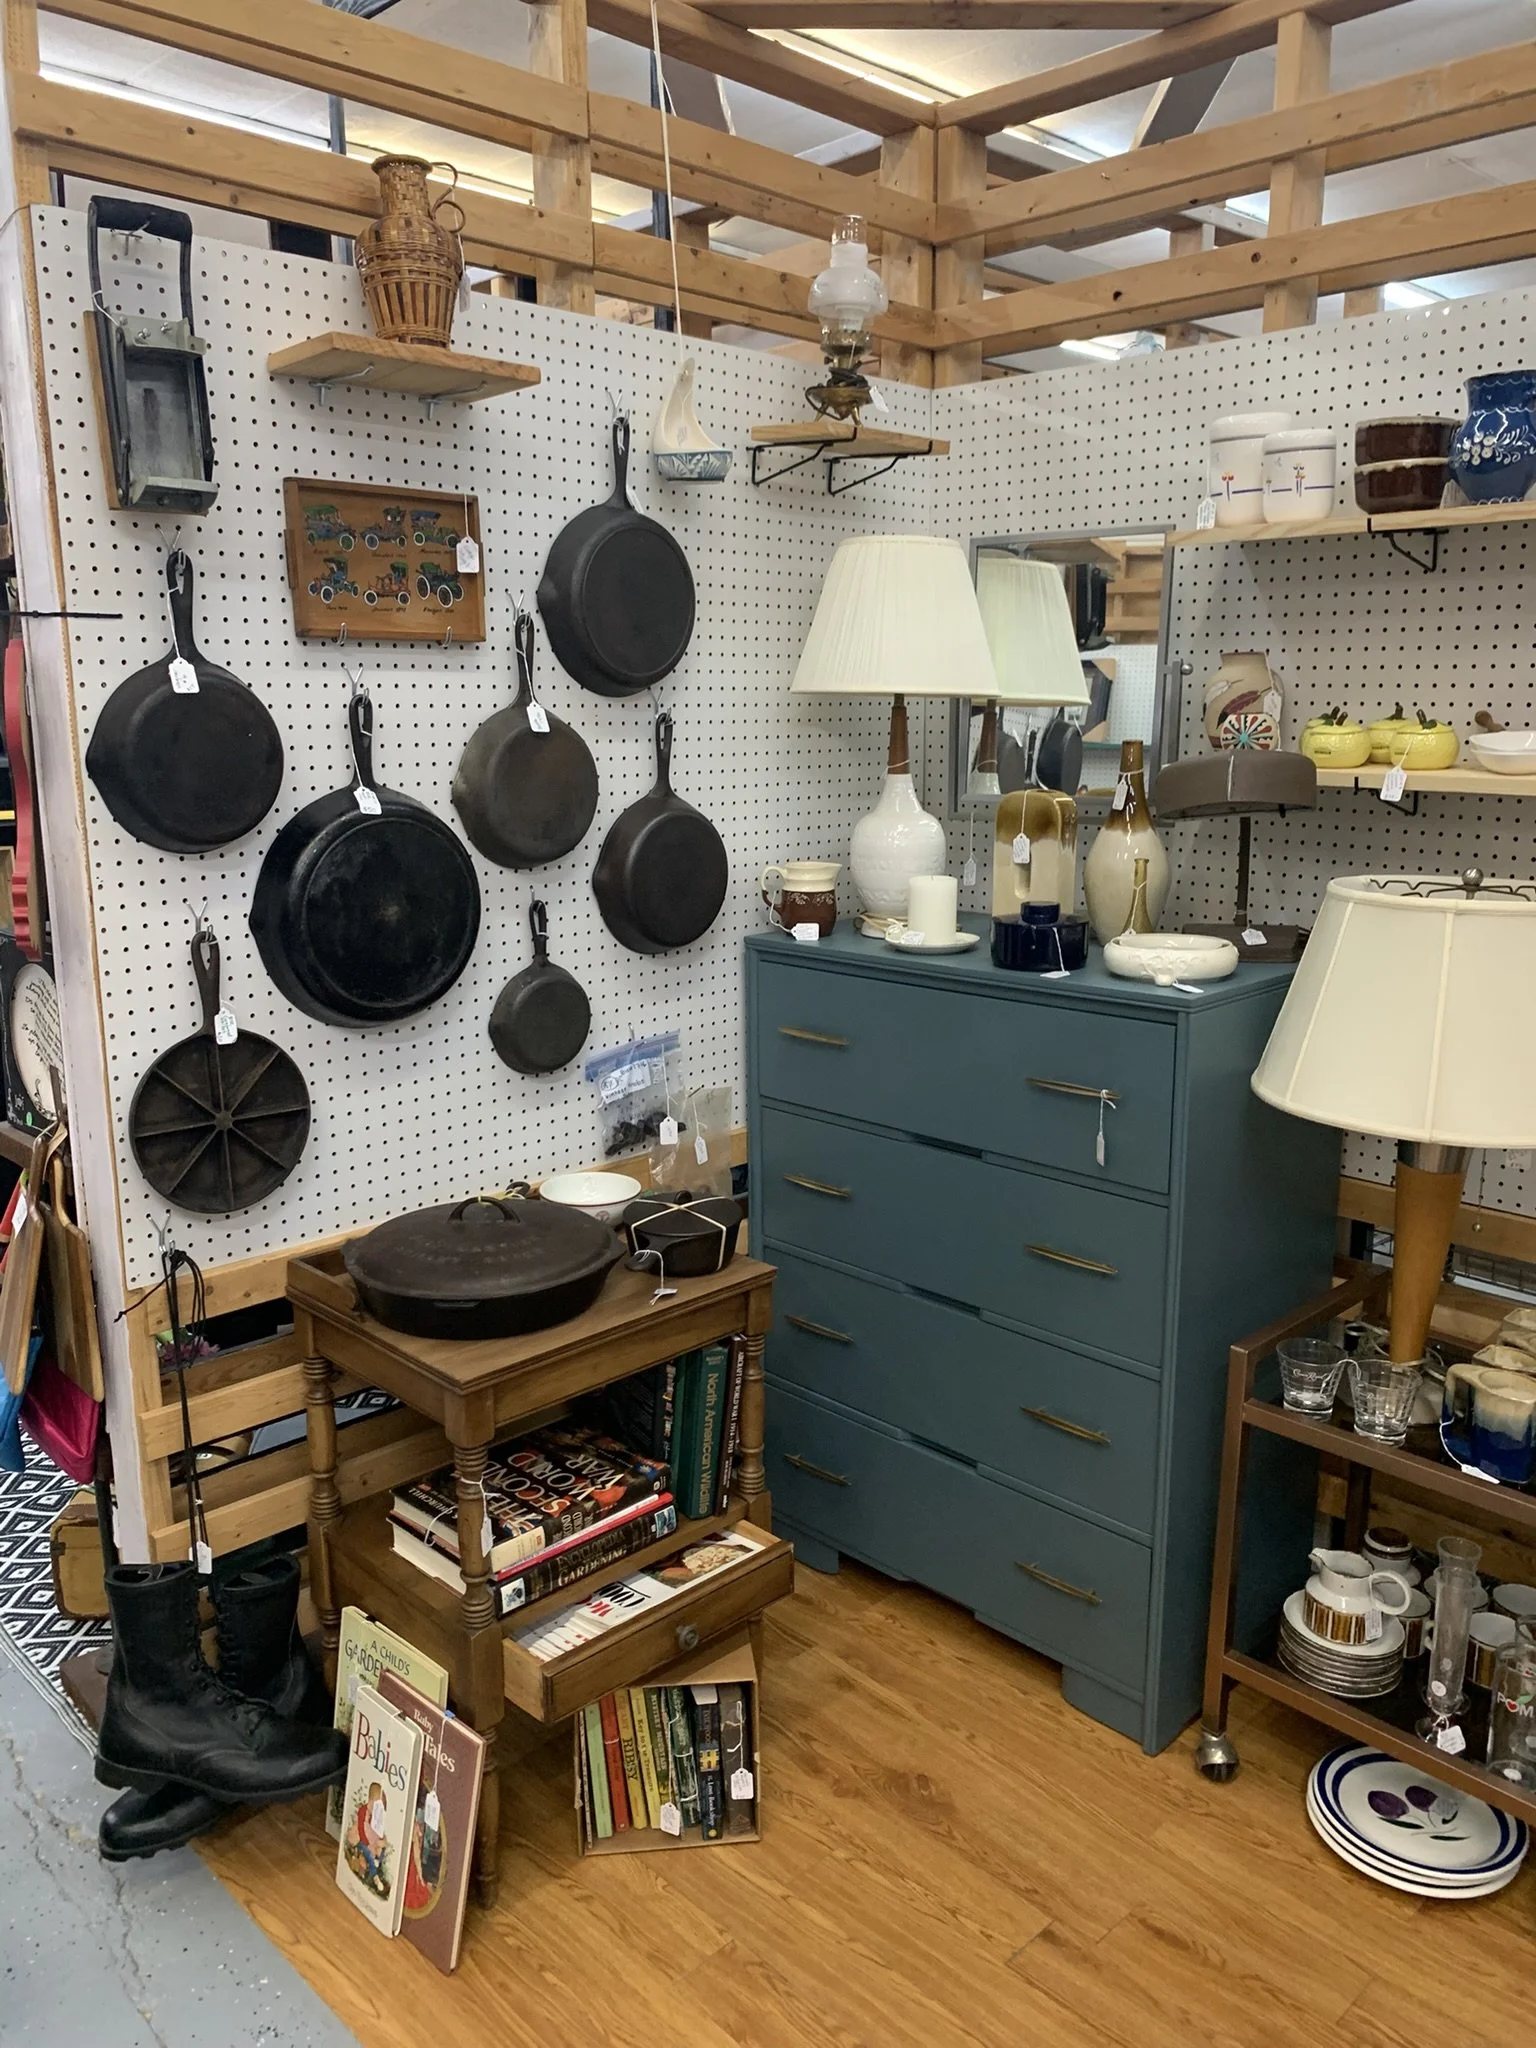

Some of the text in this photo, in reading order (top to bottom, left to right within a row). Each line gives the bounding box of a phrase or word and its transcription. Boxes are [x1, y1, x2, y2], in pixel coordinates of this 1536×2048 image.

[707, 1373, 720, 1406] North
[733, 1385, 741, 1404] WORLD
[702, 1409, 716, 1471] American
[482, 1461, 571, 1514] SECOND
[508, 1452, 597, 1501] WORLD
[563, 1454, 625, 1494] WAR
[699, 1470, 712, 1515] Wildlife
[557, 1547, 628, 1587] GARDENING
[370, 1640, 410, 1676] A CHILD'S
[414, 1708, 433, 1733] Ruby
[354, 1711, 408, 1792] Babies
[424, 1734, 455, 1773] Tales
[623, 1738, 638, 1781] RIBSY
[644, 1758, 654, 1792] Treasure
